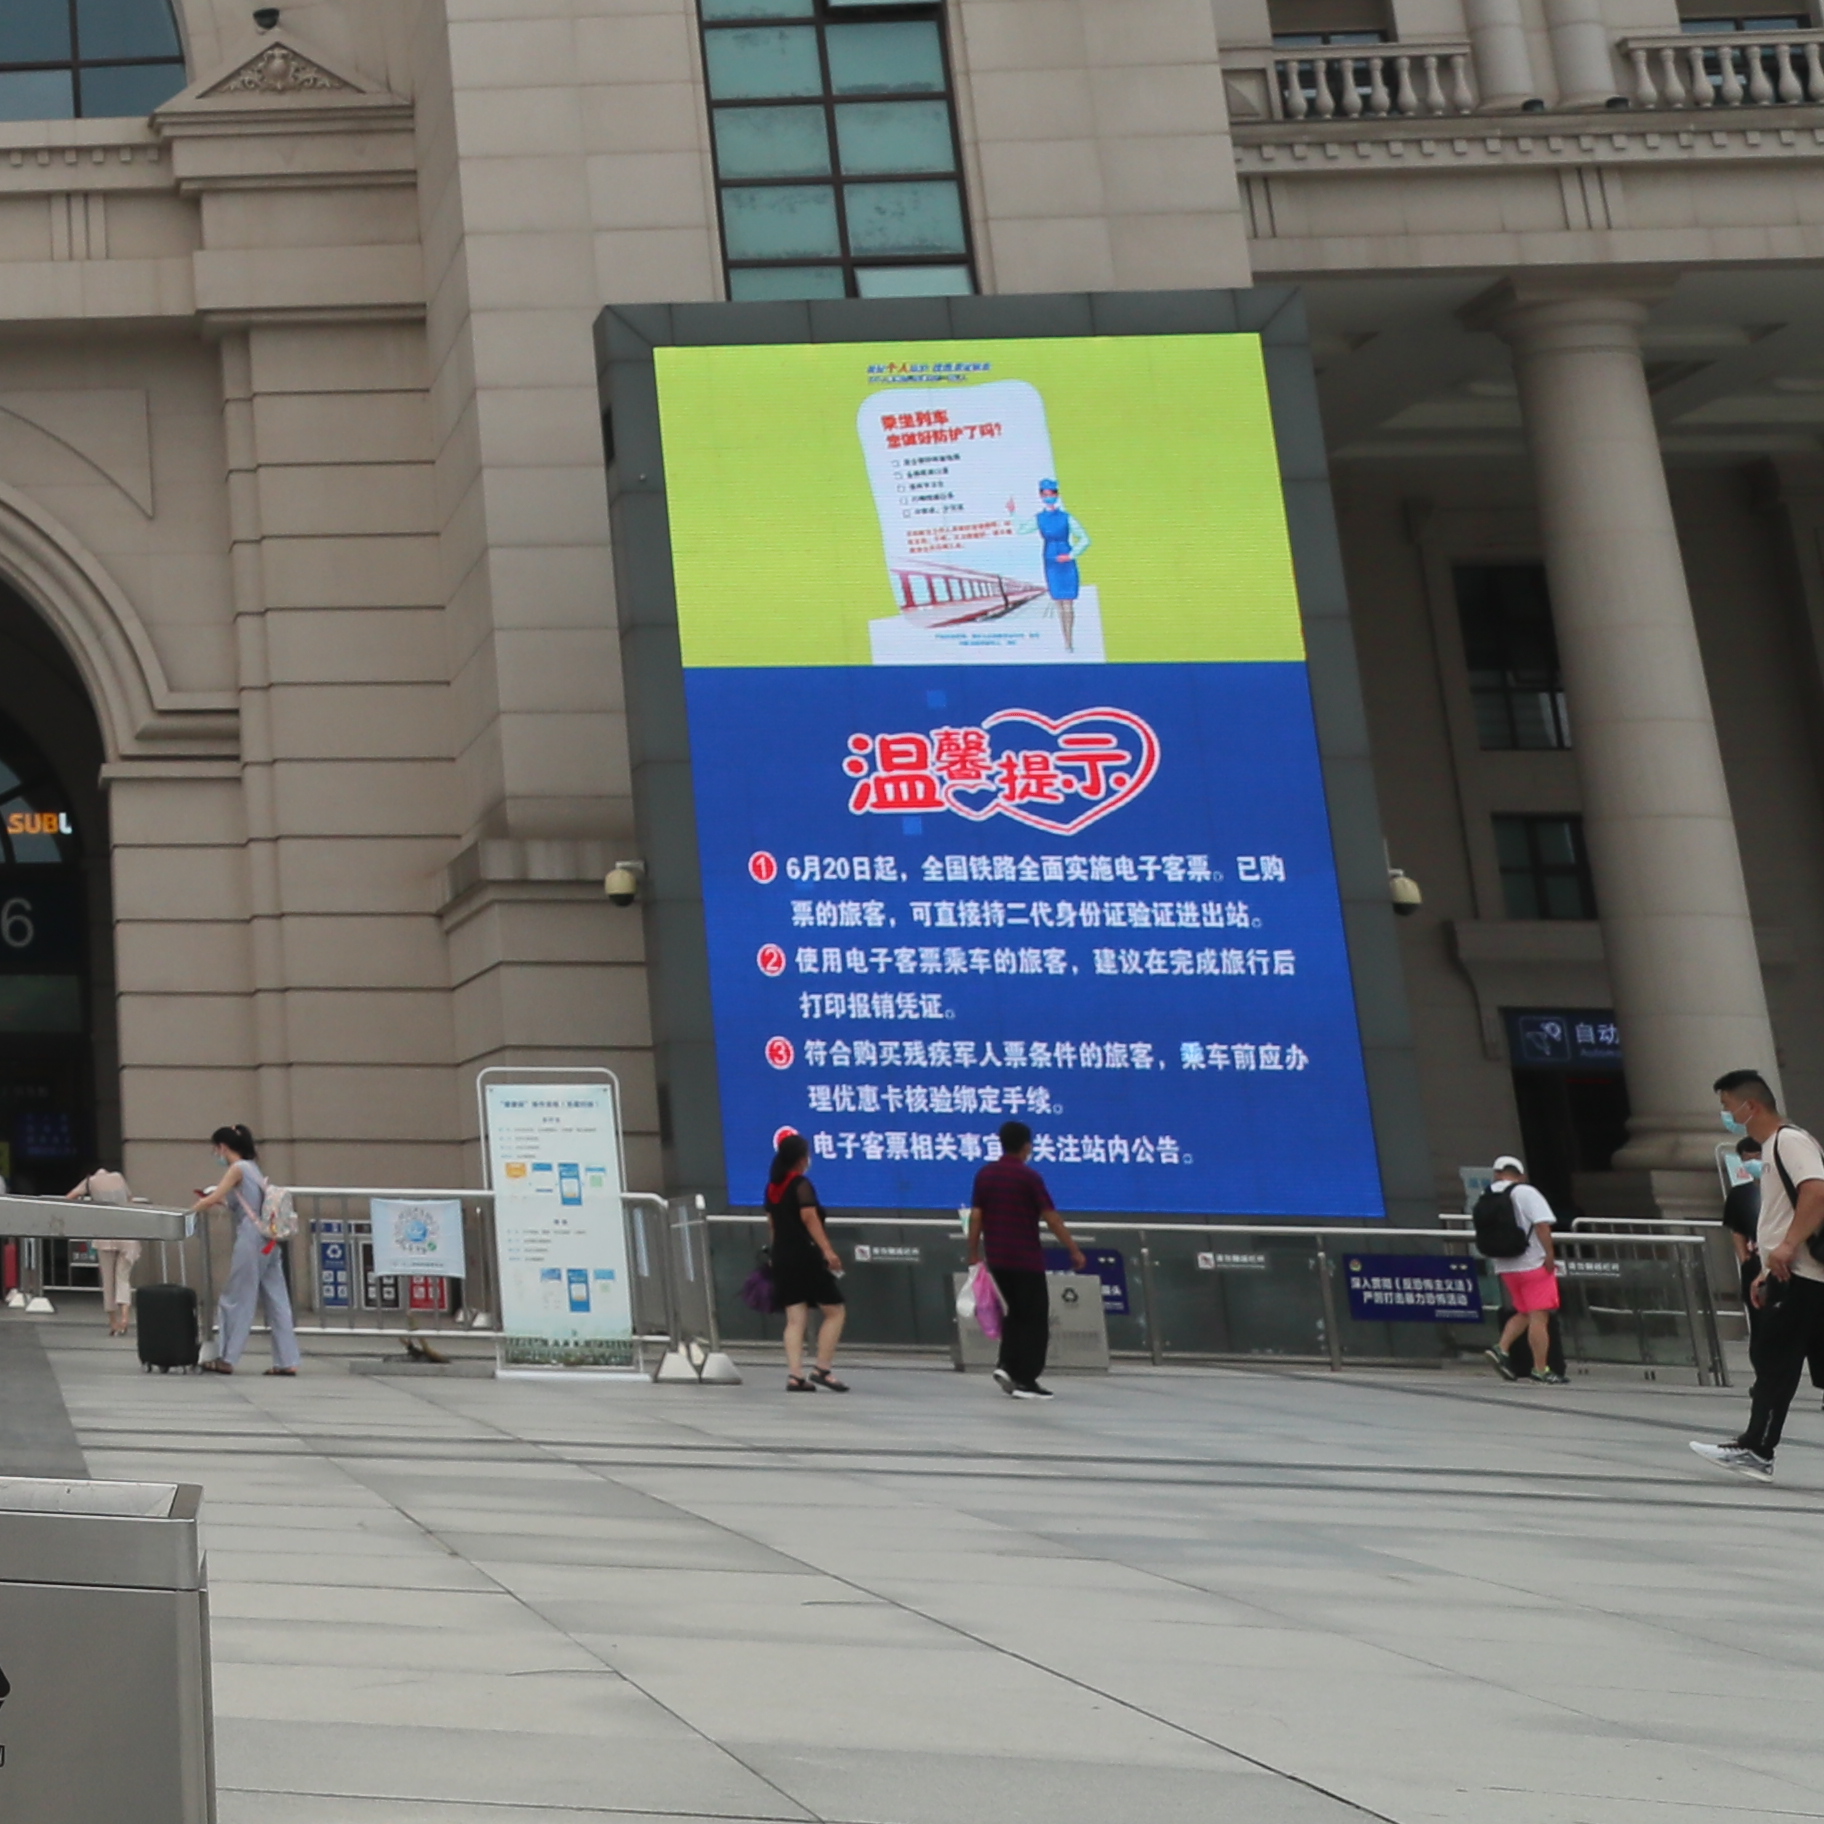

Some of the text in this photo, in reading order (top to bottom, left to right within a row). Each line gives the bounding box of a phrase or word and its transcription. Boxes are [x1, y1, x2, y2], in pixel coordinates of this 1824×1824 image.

[842, 725, 1132, 815] 温馨提示
[0, 897, 35, 949] 6
[813, 1130, 1193, 1165] 电子客票相关事宜关注站内公告。
